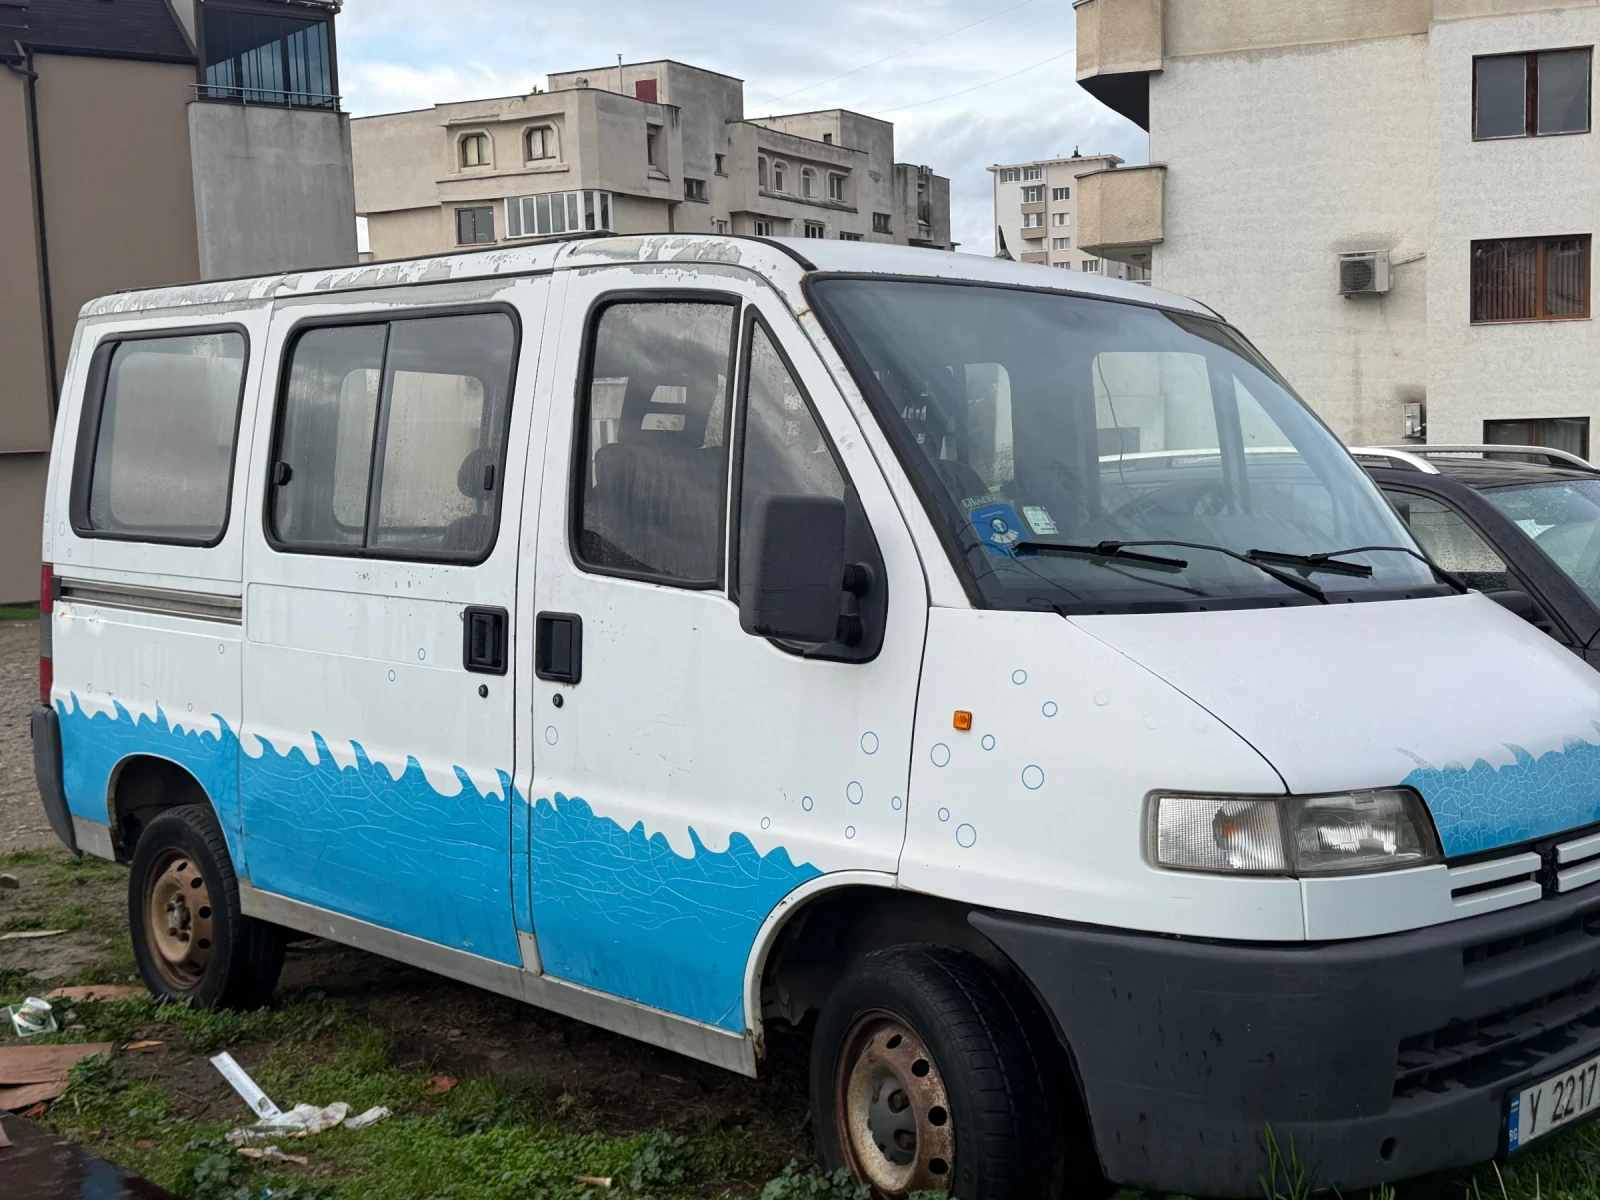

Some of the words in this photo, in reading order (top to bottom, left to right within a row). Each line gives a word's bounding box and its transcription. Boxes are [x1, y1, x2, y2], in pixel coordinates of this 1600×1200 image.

[1529, 1089, 1542, 1134] Y
[1551, 1063, 1598, 1124] 2217
[1509, 1127, 1518, 1142] BG
